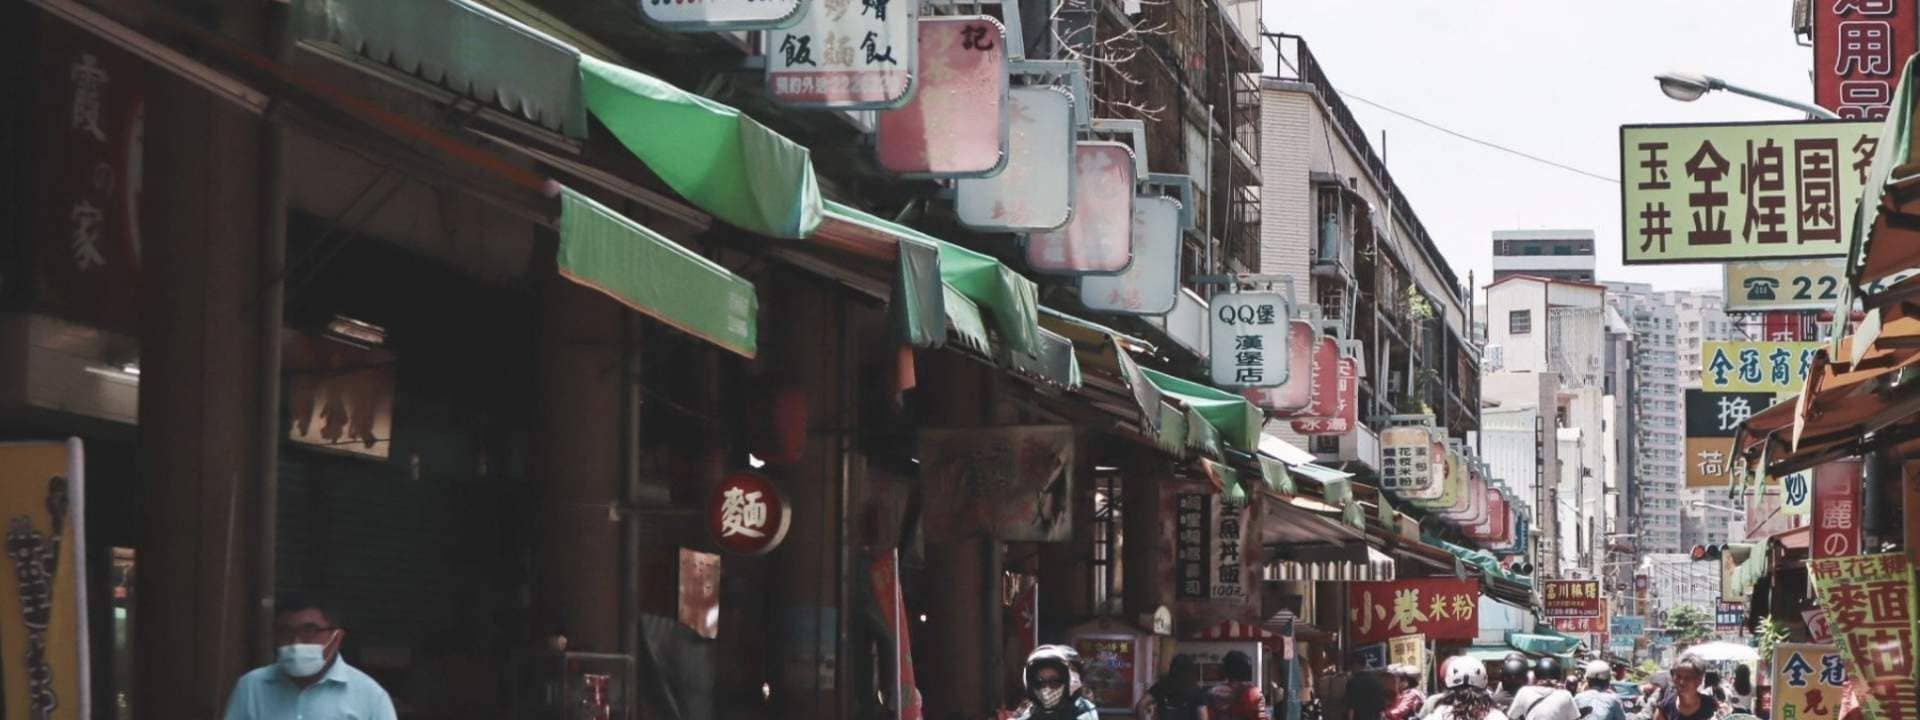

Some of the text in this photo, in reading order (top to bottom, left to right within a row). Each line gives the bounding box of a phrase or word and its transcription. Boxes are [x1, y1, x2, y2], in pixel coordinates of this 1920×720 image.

[779, 33, 817, 67] 飯
[1833, 0, 1893, 119] 用品
[1638, 142, 1673, 253] 玉井
[1684, 137, 1842, 245] 金煌園
[1218, 304, 1275, 326] QQ堡
[1235, 335, 1264, 383] 漢堡店
[720, 486, 768, 538] 麵
[1822, 476, 1853, 556] 麗の
[1351, 588, 1475, 634] 小卷米粉
